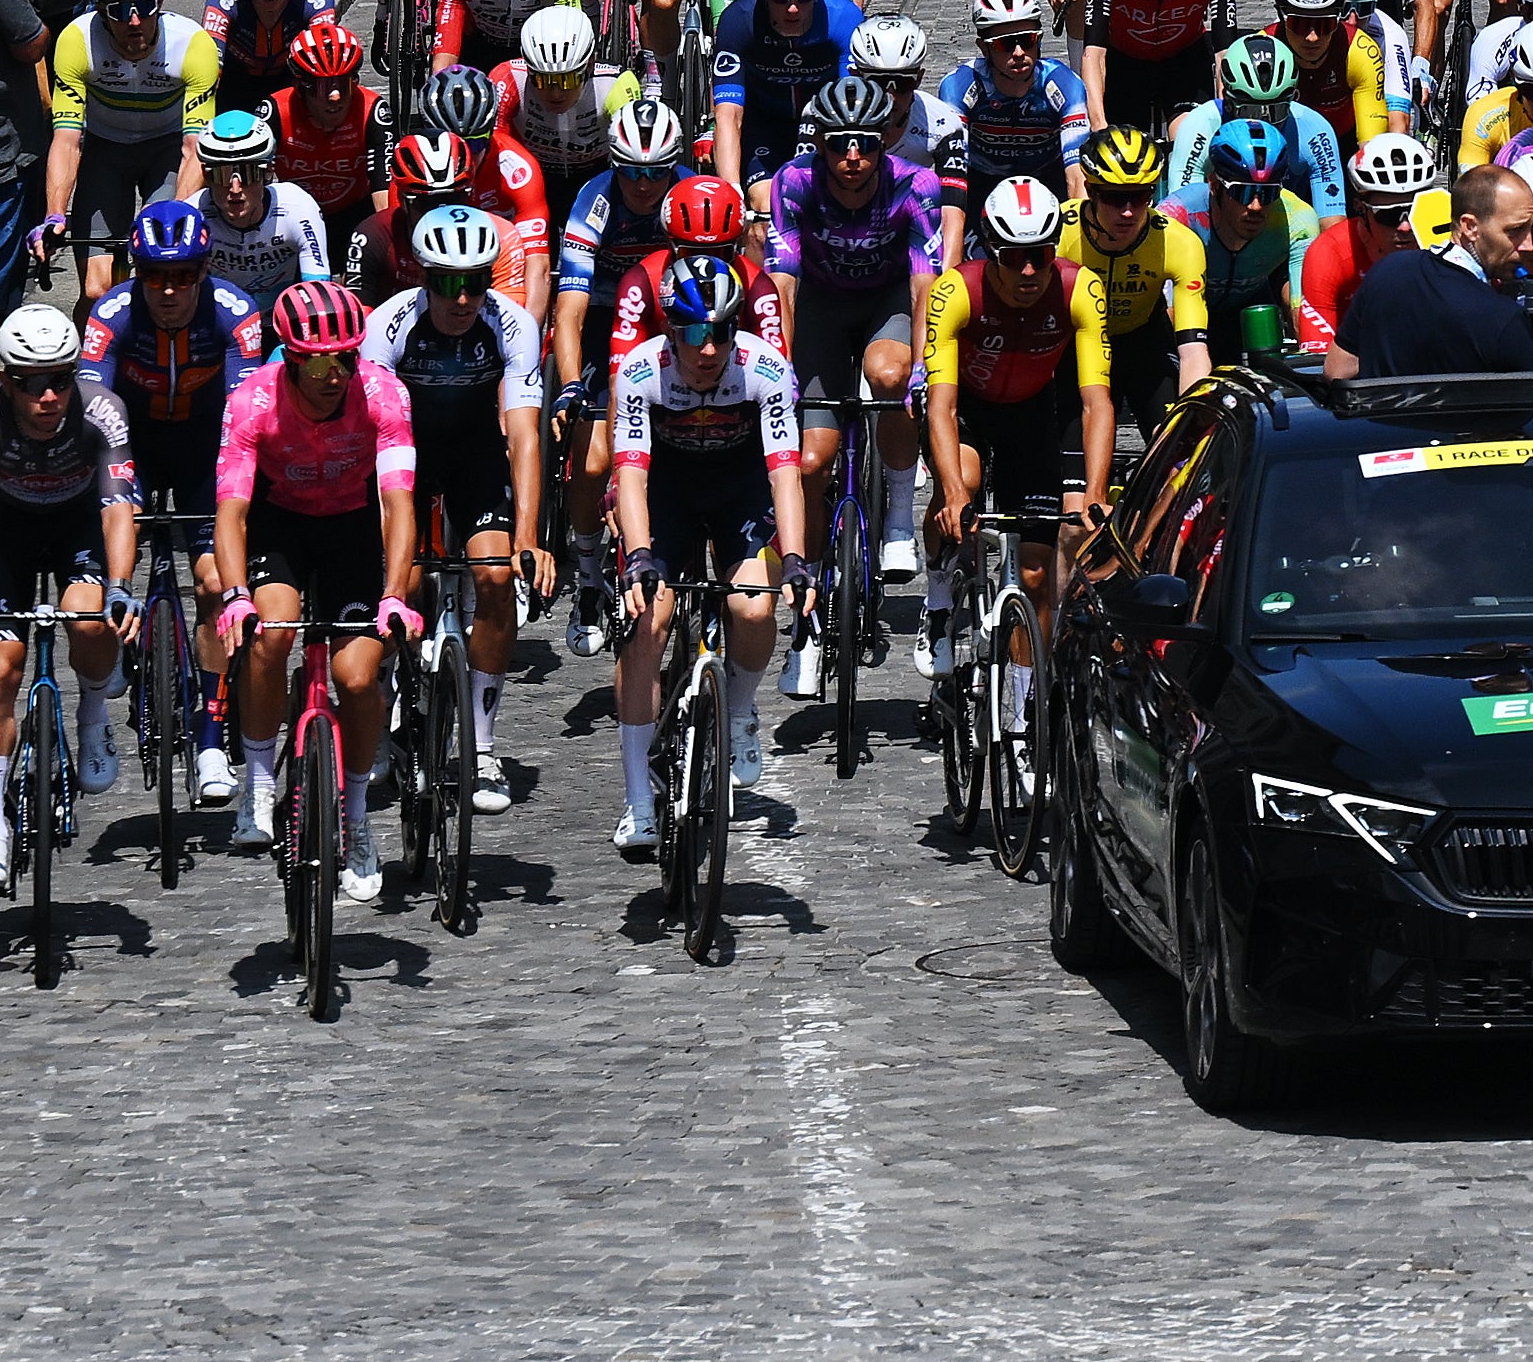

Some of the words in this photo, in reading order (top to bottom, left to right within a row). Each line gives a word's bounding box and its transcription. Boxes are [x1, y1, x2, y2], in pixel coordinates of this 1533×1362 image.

[1116, 4, 1203, 21] ARKEA
[1355, 35, 1387, 103] Cofidis
[1393, 43, 1410, 97] MERIDA
[1181, 133, 1207, 188] DECATHLON
[299, 219, 324, 268] MERIDA
[811, 225, 896, 248] Jayco
[345, 232, 367, 291] INEOS
[922, 279, 956, 361] Cofidis
[623, 358, 650, 378] BORA
[757, 354, 786, 374] BORA
[85, 395, 130, 446] Alpecin
[627, 394, 645, 440] BOSS
[768, 391, 789, 440] BOSS
[1435, 452, 1443, 461] 1
[1452, 448, 1509, 461] RACE
